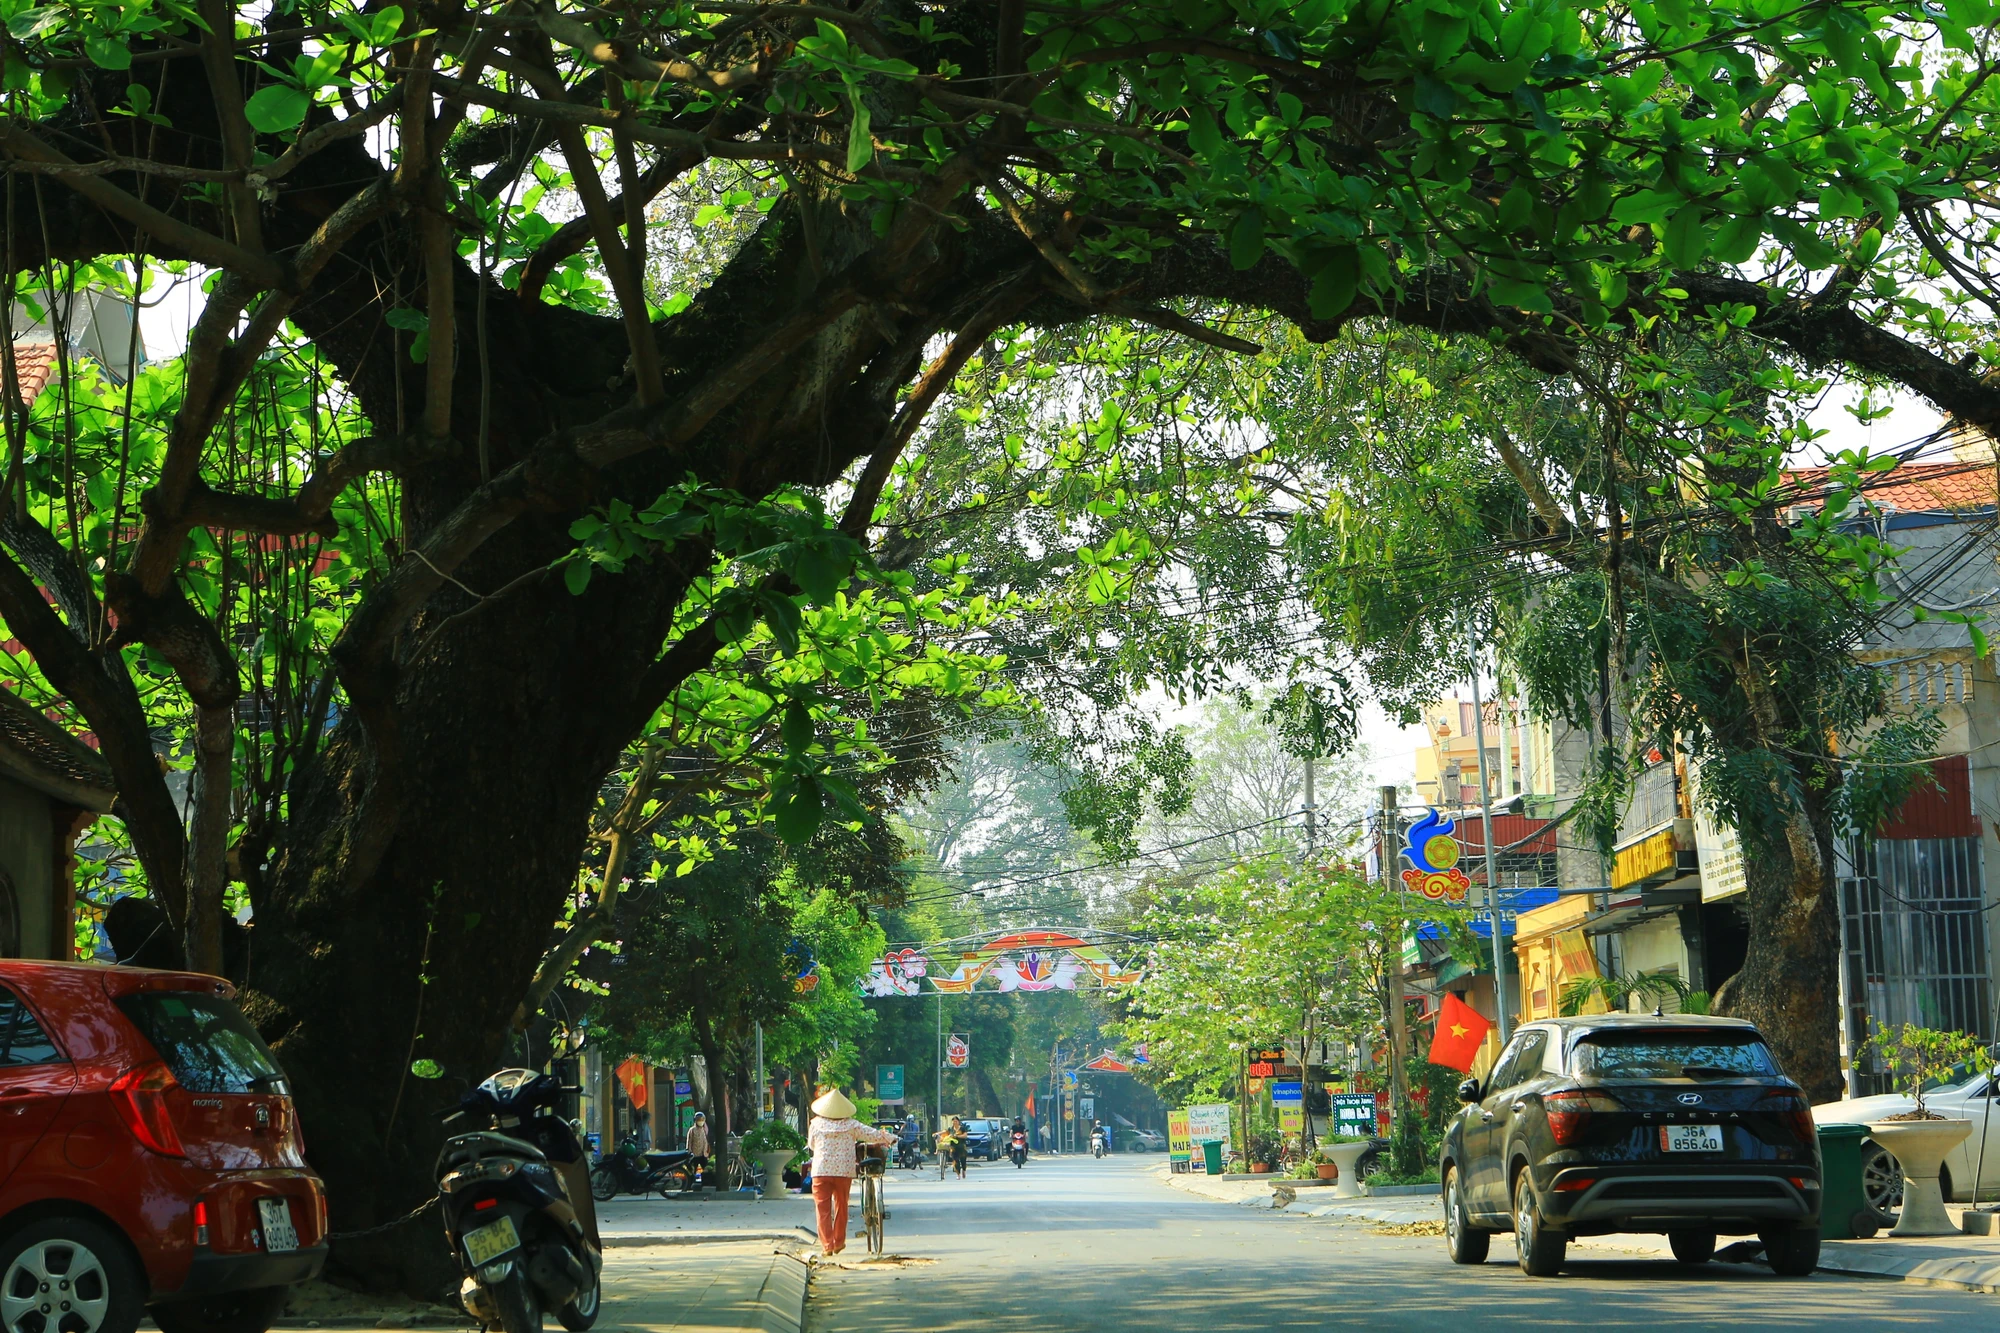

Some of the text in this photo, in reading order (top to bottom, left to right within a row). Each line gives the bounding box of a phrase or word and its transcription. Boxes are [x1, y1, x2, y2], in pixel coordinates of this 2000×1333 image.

[193, 1099, 223, 1109] morning
[1681, 1126, 1706, 1137] 36A
[1674, 1138, 1718, 1150] 856.40
[266, 1202, 285, 1224] 36A
